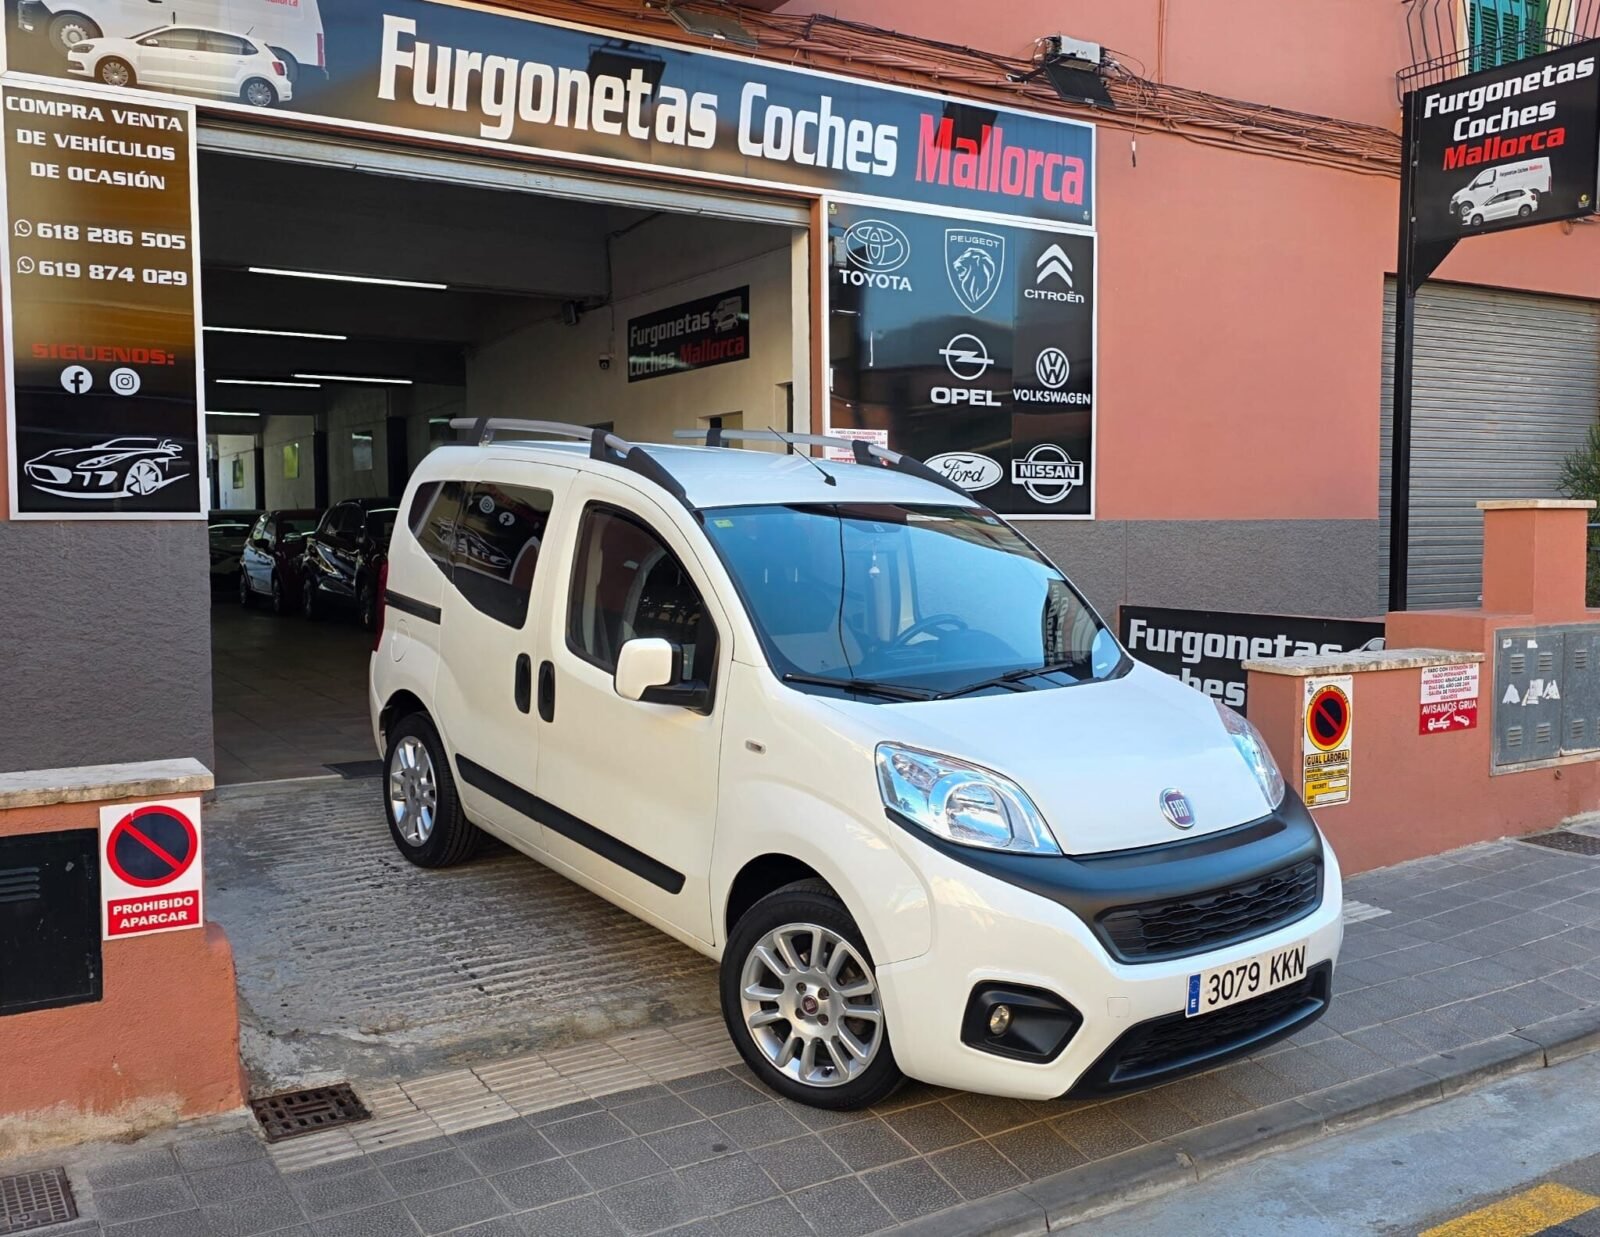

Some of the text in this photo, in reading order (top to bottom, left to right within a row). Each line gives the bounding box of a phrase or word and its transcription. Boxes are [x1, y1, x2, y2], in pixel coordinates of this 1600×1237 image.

[1424, 56, 1595, 119] Furgonetas
[6, 96, 183, 131] COMPRA VENTA
[377, 13, 1085, 206] Furgonetas Coches Mallorca
[1453, 100, 1557, 142] Coches
[16, 128, 175, 161] DE VEHÍCULOS
[1442, 127, 1566, 171] Mallorca
[30, 162, 165, 190] DE OCASIÓN
[37, 223, 186, 250] 618 286 505
[950, 235, 1000, 248] PEUGEOT
[39, 260, 188, 286] 619 874 029
[839, 269, 912, 292] TOYOTA
[630, 311, 711, 348] Furgonetas
[31, 343, 175, 366] SIGUENOS:
[681, 335, 745, 364] Mallorca
[930, 387, 1002, 407] OPEL
[1013, 388, 1091, 405] VOLKSWAGEN
[943, 458, 985, 482] Ford
[1019, 465, 1077, 479] NISSAN
[1422, 700, 1477, 715] AVISAMOS GRUA
[1323, 752, 1348, 764] LABORAL
[1168, 799, 1190, 818] FIAT
[113, 897, 193, 915] PROHIBIDO
[119, 911, 188, 928] APARCAR
[1208, 945, 1305, 1005] 3079 KKN
